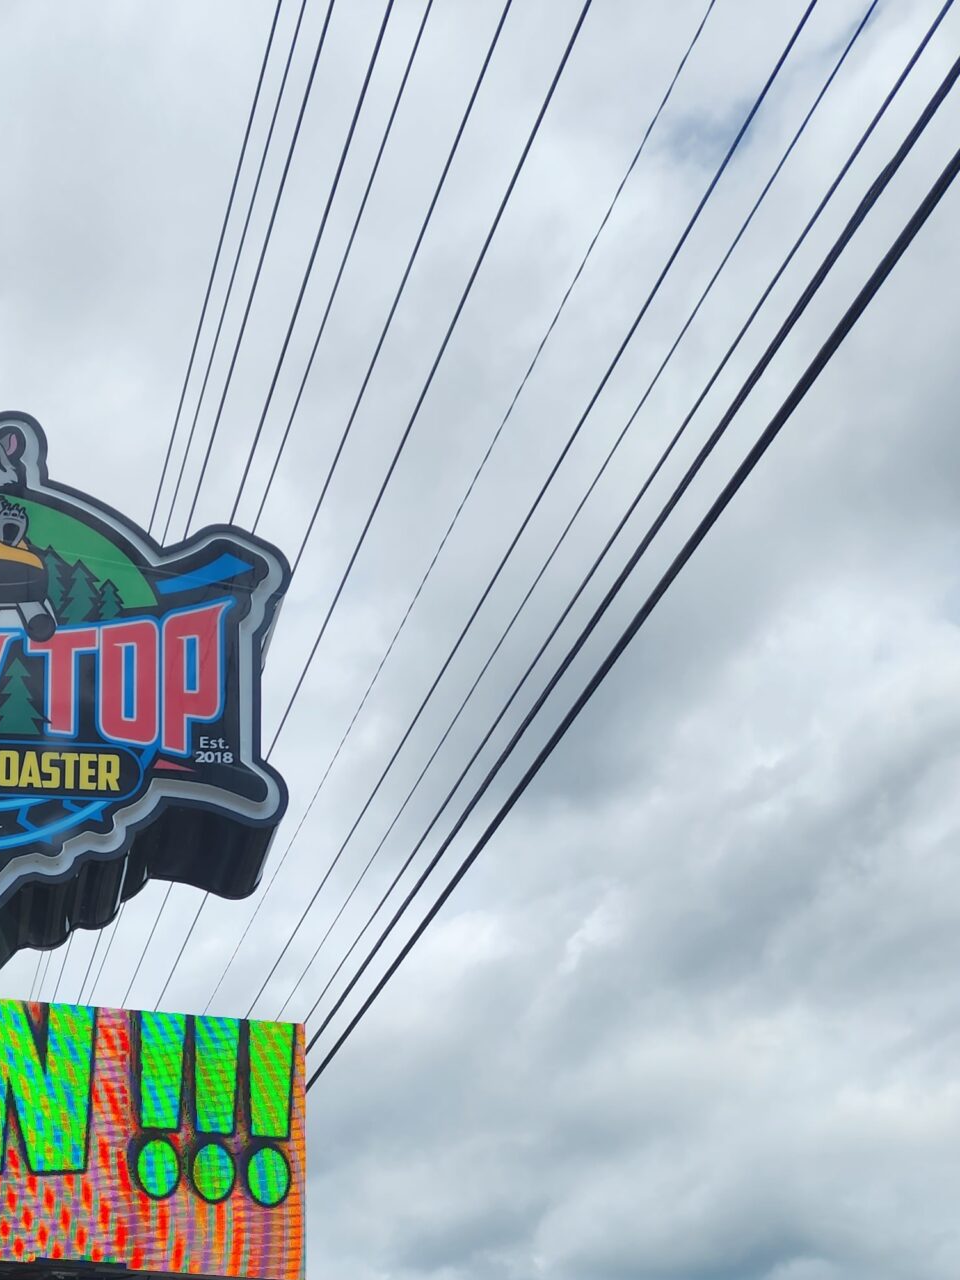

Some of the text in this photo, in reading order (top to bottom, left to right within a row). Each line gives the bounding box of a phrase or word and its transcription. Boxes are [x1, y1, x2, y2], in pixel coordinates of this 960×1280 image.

[26, 600, 232, 755] TOP
[200, 736, 230, 749] Est.
[195, 751, 234, 763] 2018
